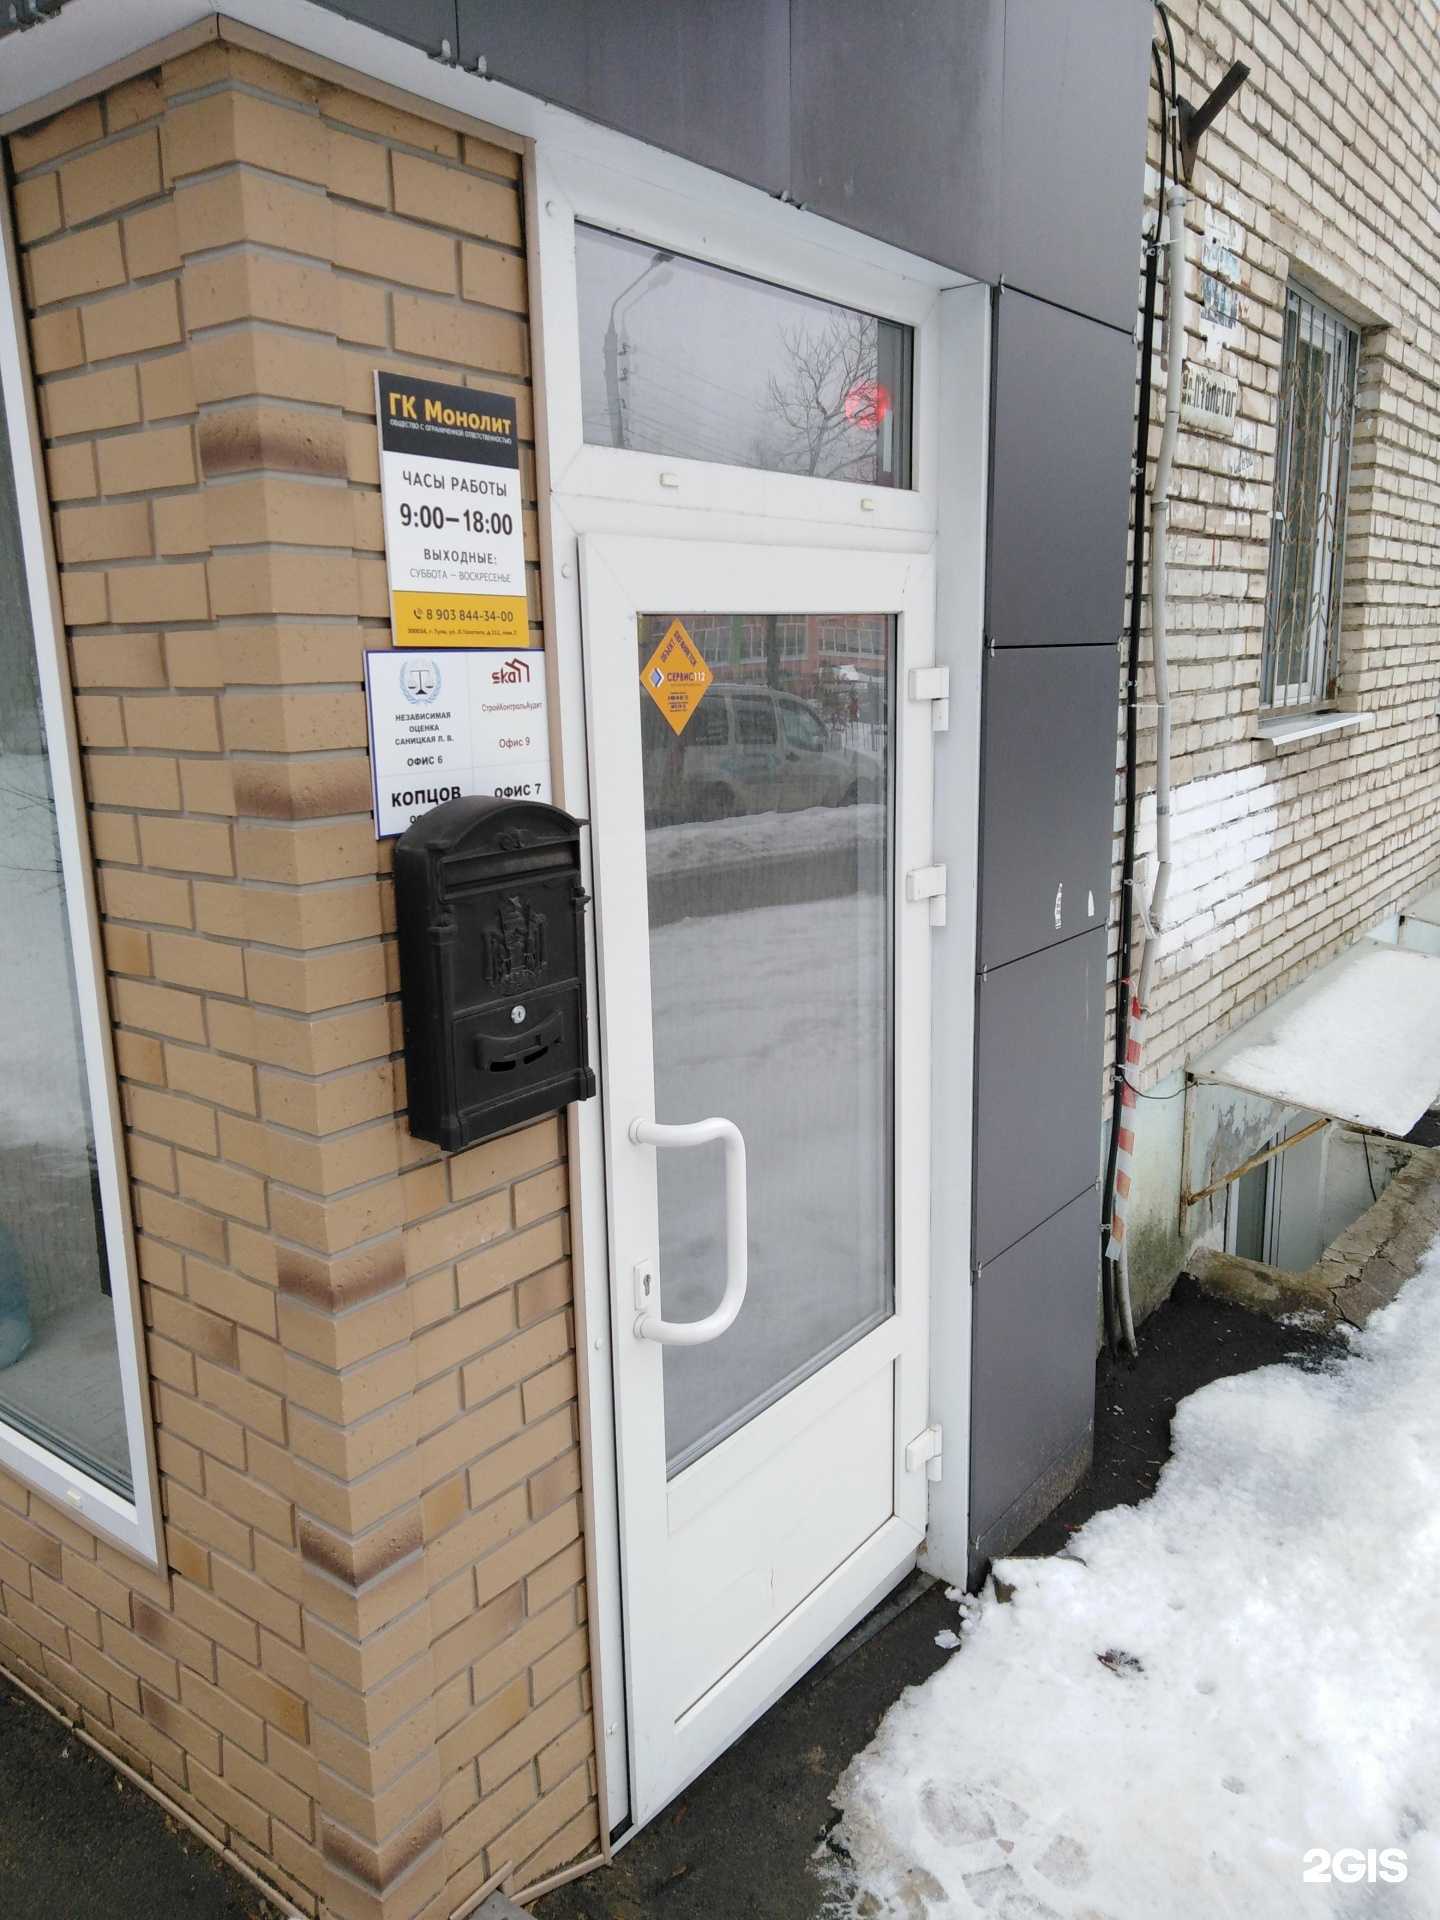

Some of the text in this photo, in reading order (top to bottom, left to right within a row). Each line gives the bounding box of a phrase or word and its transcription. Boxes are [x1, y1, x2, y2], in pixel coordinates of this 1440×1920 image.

[389, 392, 512, 435] ГК Монолит
[402, 470, 508, 497] ЧАСЫ РАБОТЫ
[424, 548, 497, 565] ВЫХОДНЫЕ:
[410, 567, 448, 580] СУББОТА
[459, 570, 512, 584] ВОСКРЕСЕНЬЕ
[426, 608, 514, 622] 8 903 844-34-00
[481, 701, 543, 713] СтройКонтрольАудит
[395, 711, 451, 722] НЕЗАВИСИМАЯ
[409, 724, 440, 734] ОЦЕНКА
[395, 735, 436, 746] САНИЦКАЯ
[499, 737, 531, 749] Офис 9
[407, 755, 443, 767] ОФИС 6
[391, 786, 462, 808] КОПЦОВ
[494, 783, 542, 799] ОФИС 7
